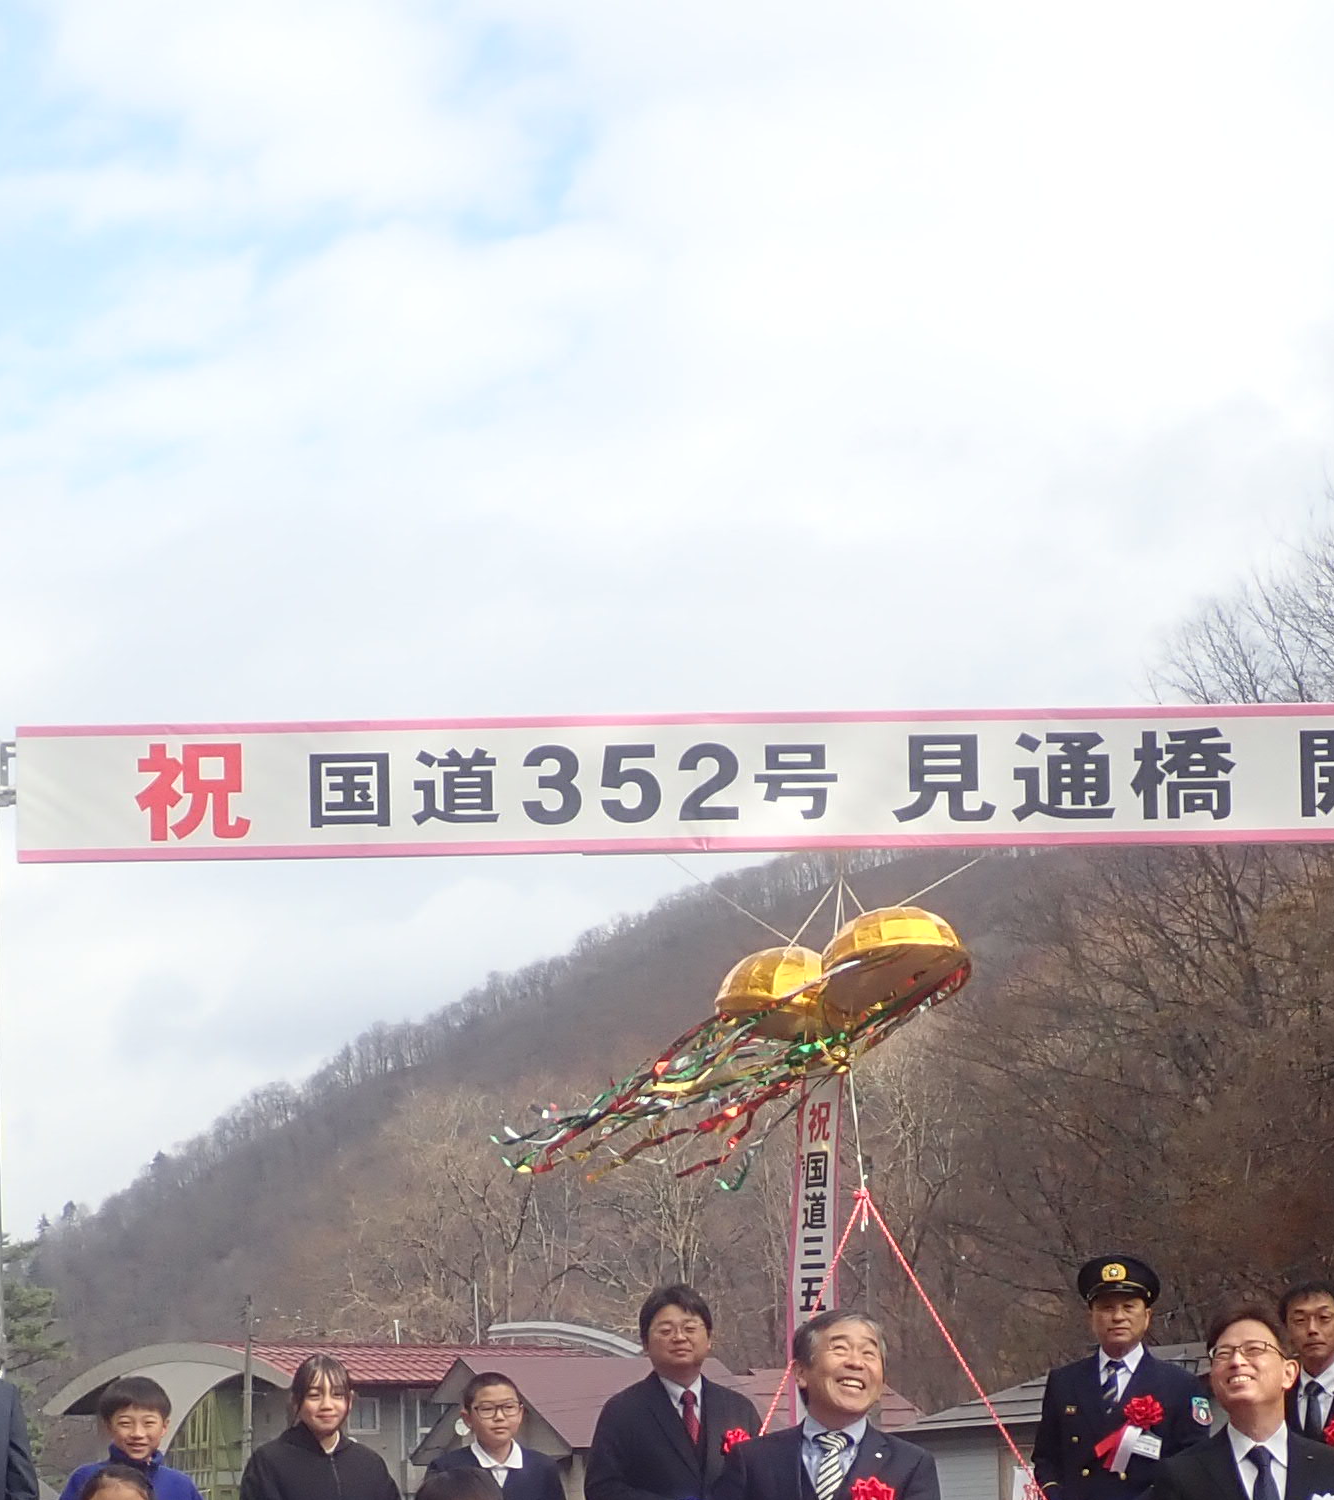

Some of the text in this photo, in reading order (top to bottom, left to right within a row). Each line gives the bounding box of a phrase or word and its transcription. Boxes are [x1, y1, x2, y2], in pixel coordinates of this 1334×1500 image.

[134, 742, 252, 842] 祝
[308, 741, 839, 829] 国道352号
[892, 727, 1237, 823] 見通橋
[799, 1102, 831, 1324] 祝国道三五
